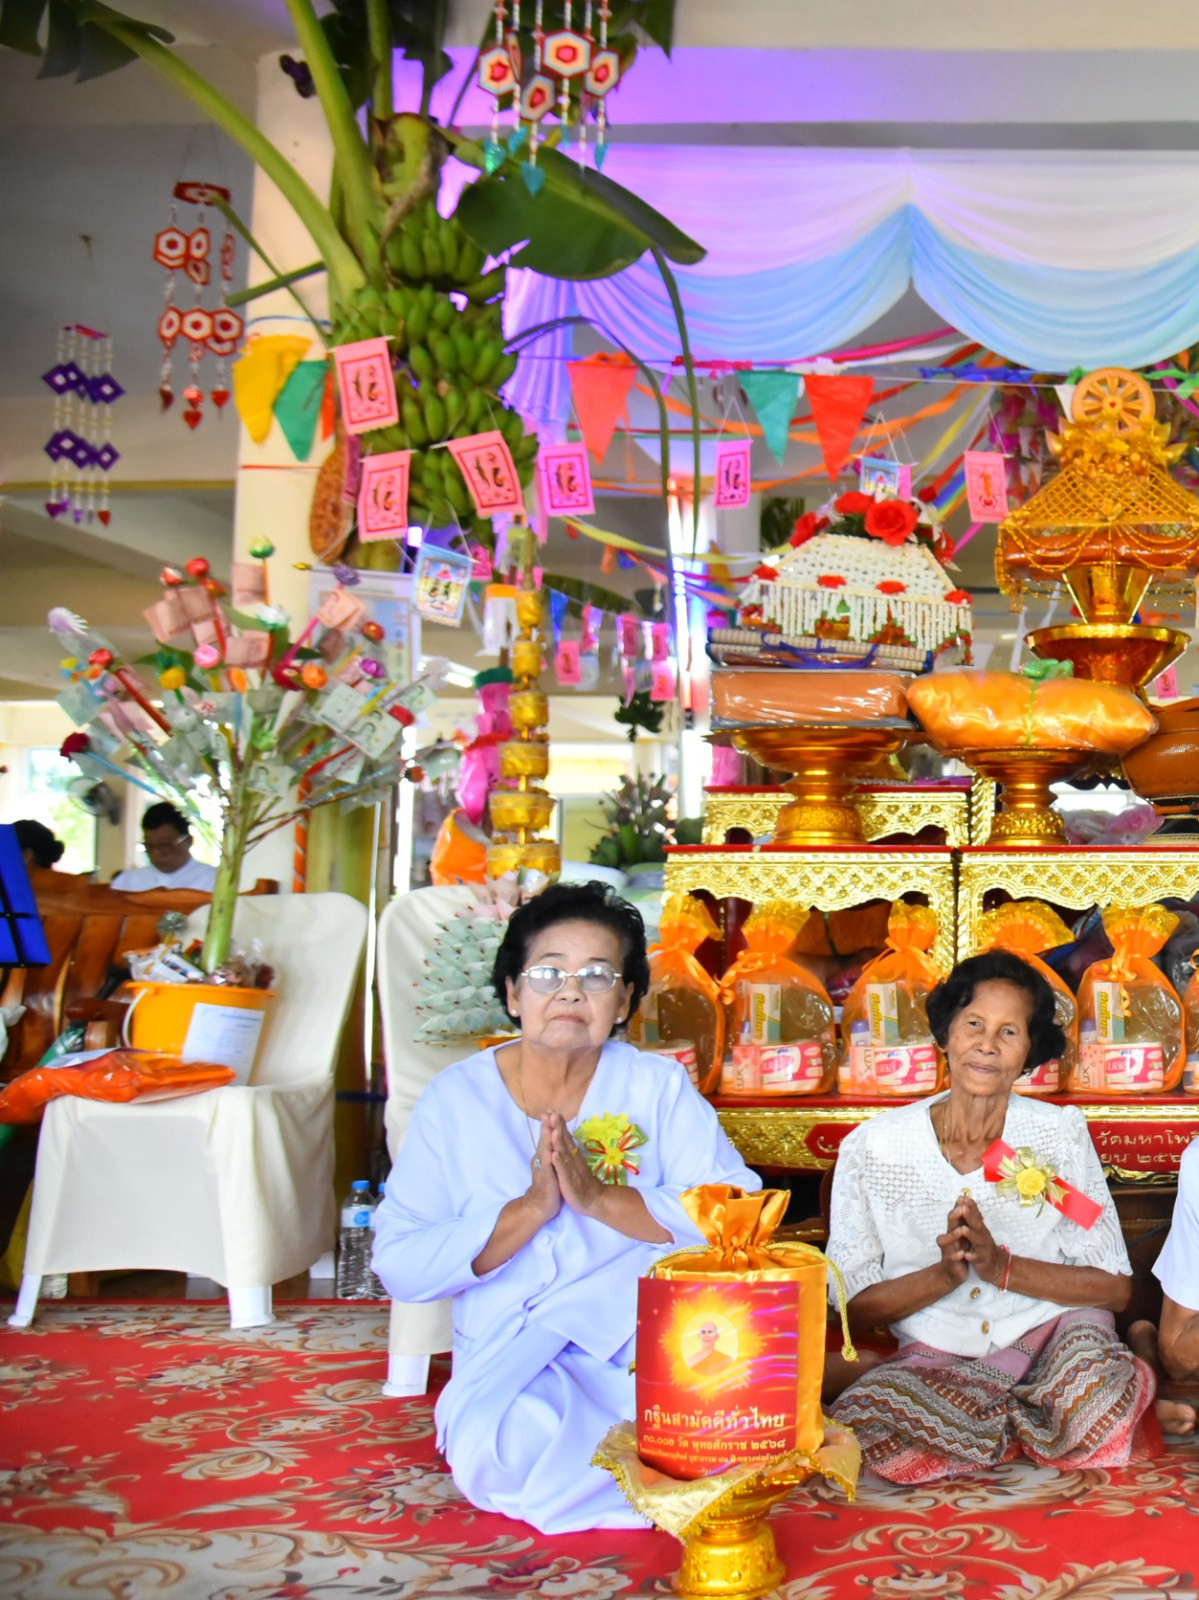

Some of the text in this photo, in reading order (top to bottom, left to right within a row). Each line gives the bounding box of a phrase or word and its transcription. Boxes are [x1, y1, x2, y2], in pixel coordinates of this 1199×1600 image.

[864, 1049, 872, 1073] LUX
[1137, 1153, 1181, 1164] ๒๕๖
[644, 1404, 786, 1429] กฐินสามัคคีทั่วไทย
[677, 1435, 689, 1448] วัด
[692, 1438, 748, 1453] พุทธศักราช
[751, 1438, 786, 1450] ๒๕๖๘
